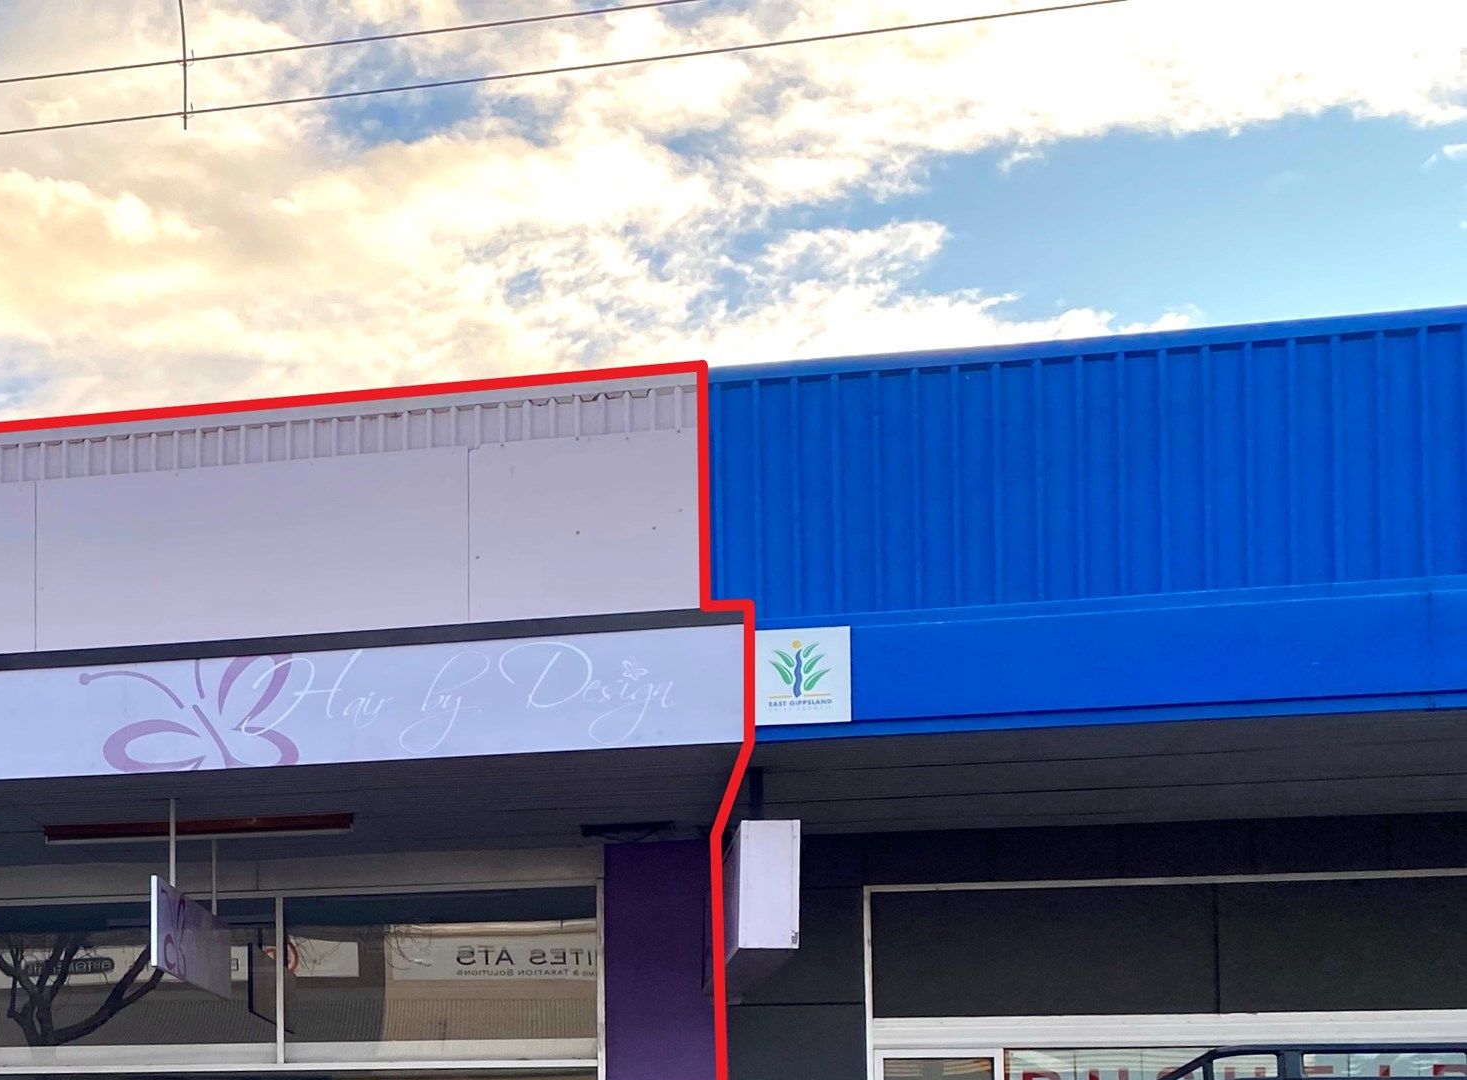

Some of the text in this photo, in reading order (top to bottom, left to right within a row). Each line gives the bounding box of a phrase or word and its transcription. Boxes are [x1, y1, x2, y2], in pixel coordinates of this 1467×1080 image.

[240, 642, 673, 754] Hair by Design
